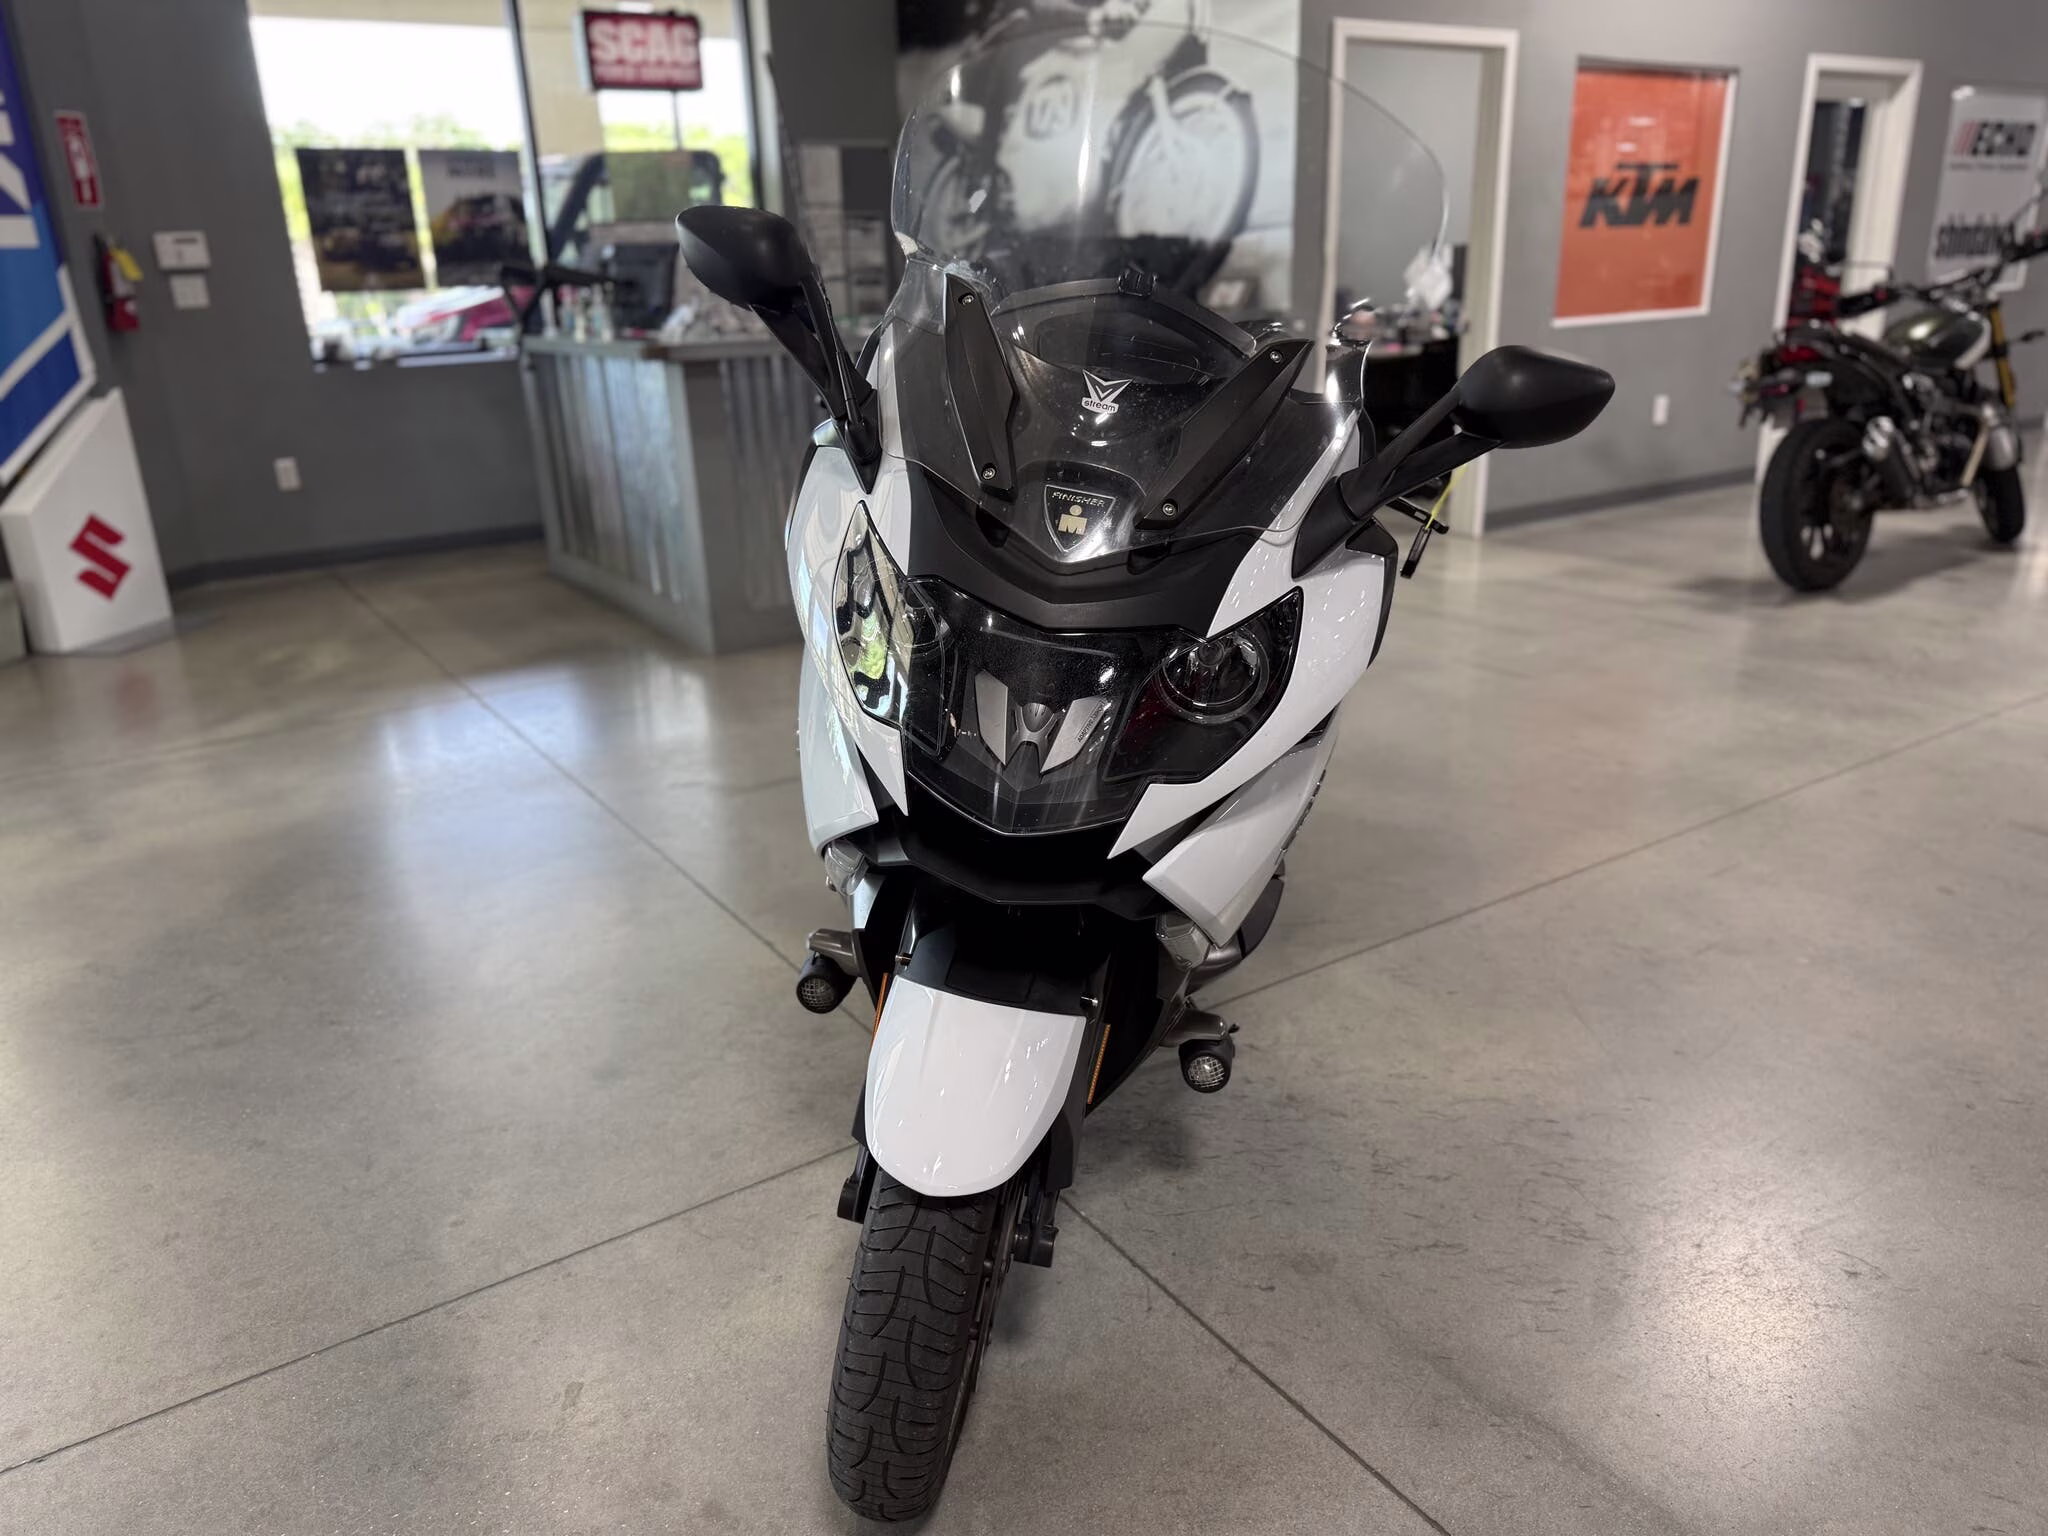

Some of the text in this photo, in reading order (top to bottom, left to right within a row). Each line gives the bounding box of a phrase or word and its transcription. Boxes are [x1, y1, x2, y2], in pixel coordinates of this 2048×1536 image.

[589, 18, 697, 63] SCAG
[1579, 162, 1699, 227] KTM
[1084, 399, 1116, 412] stream
[1052, 491, 1105, 508] FINISHER
